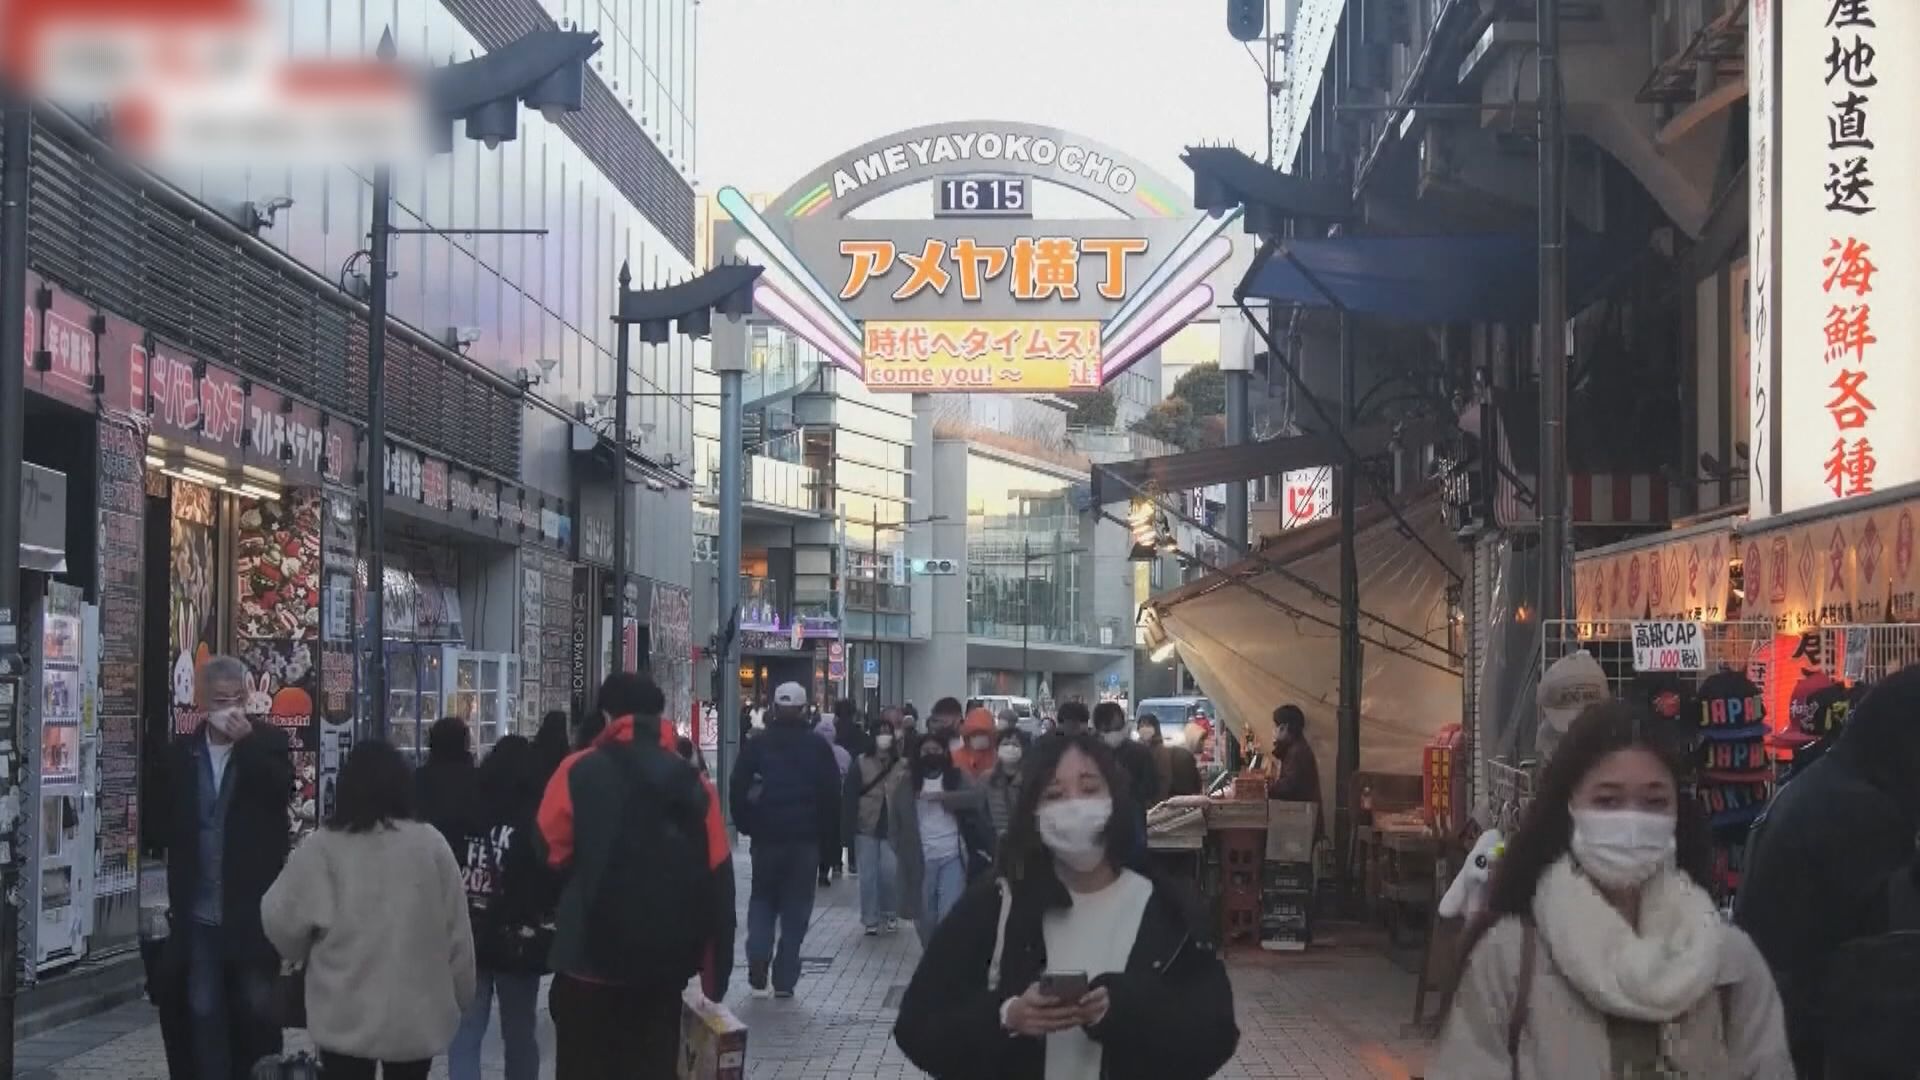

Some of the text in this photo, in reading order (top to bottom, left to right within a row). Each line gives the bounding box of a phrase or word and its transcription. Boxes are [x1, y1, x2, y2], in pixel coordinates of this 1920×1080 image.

[832, 132, 1136, 199] AMEYAYOKOCHO
[946, 181, 1022, 209] 16 15
[838, 237, 1149, 302] アメヤ横丁
[871, 366, 933, 383] come
[940, 364, 993, 386] you!
[1822, 237, 1879, 498] 海鮮各種
[1634, 622, 1697, 649] 高級CAP
